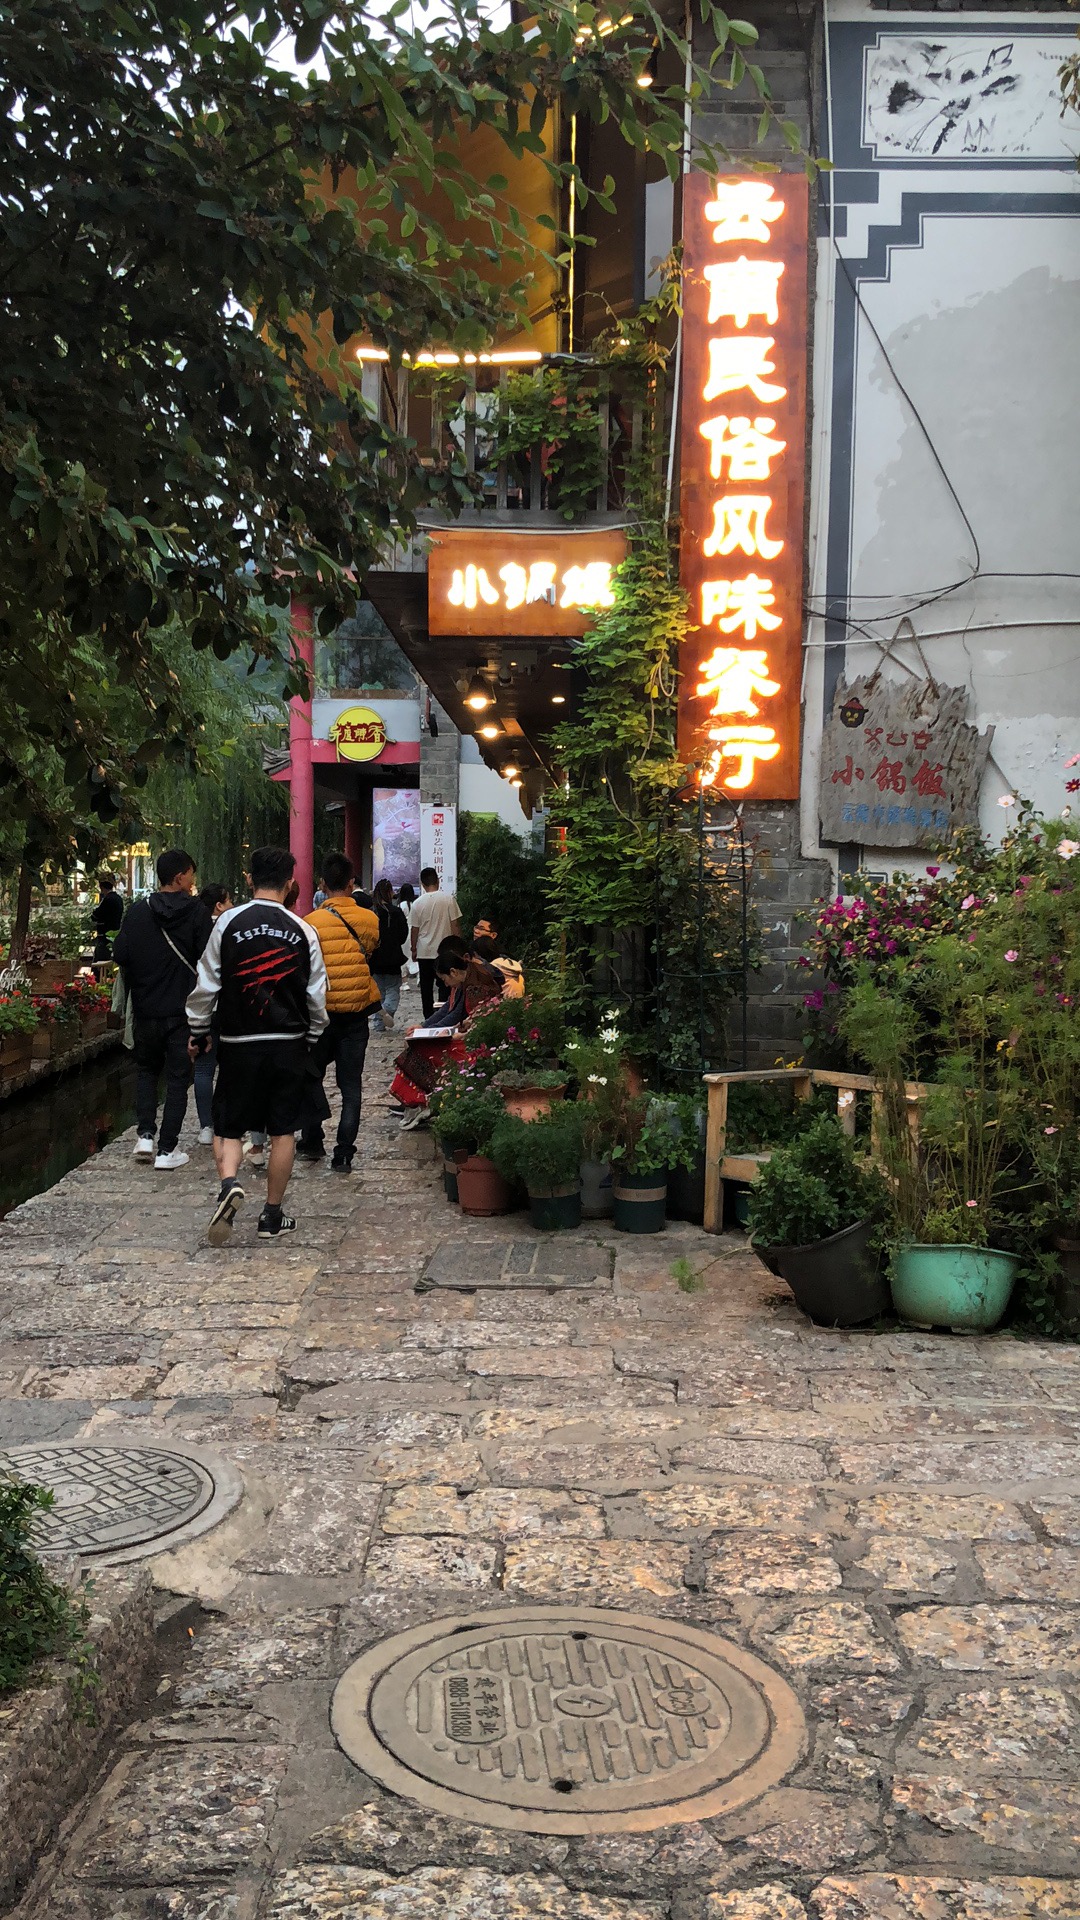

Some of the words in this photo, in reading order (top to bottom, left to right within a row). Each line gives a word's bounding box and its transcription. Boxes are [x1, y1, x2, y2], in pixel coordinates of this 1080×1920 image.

[697, 180, 787, 789] 云南民俗风味餐厅
[831, 756, 947, 799] 小锅饭
[232, 923, 302, 945] XgxFamily
[449, 1676, 473, 1737] 0888-5110388
[473, 1676, 502, 1736] 建平管业
